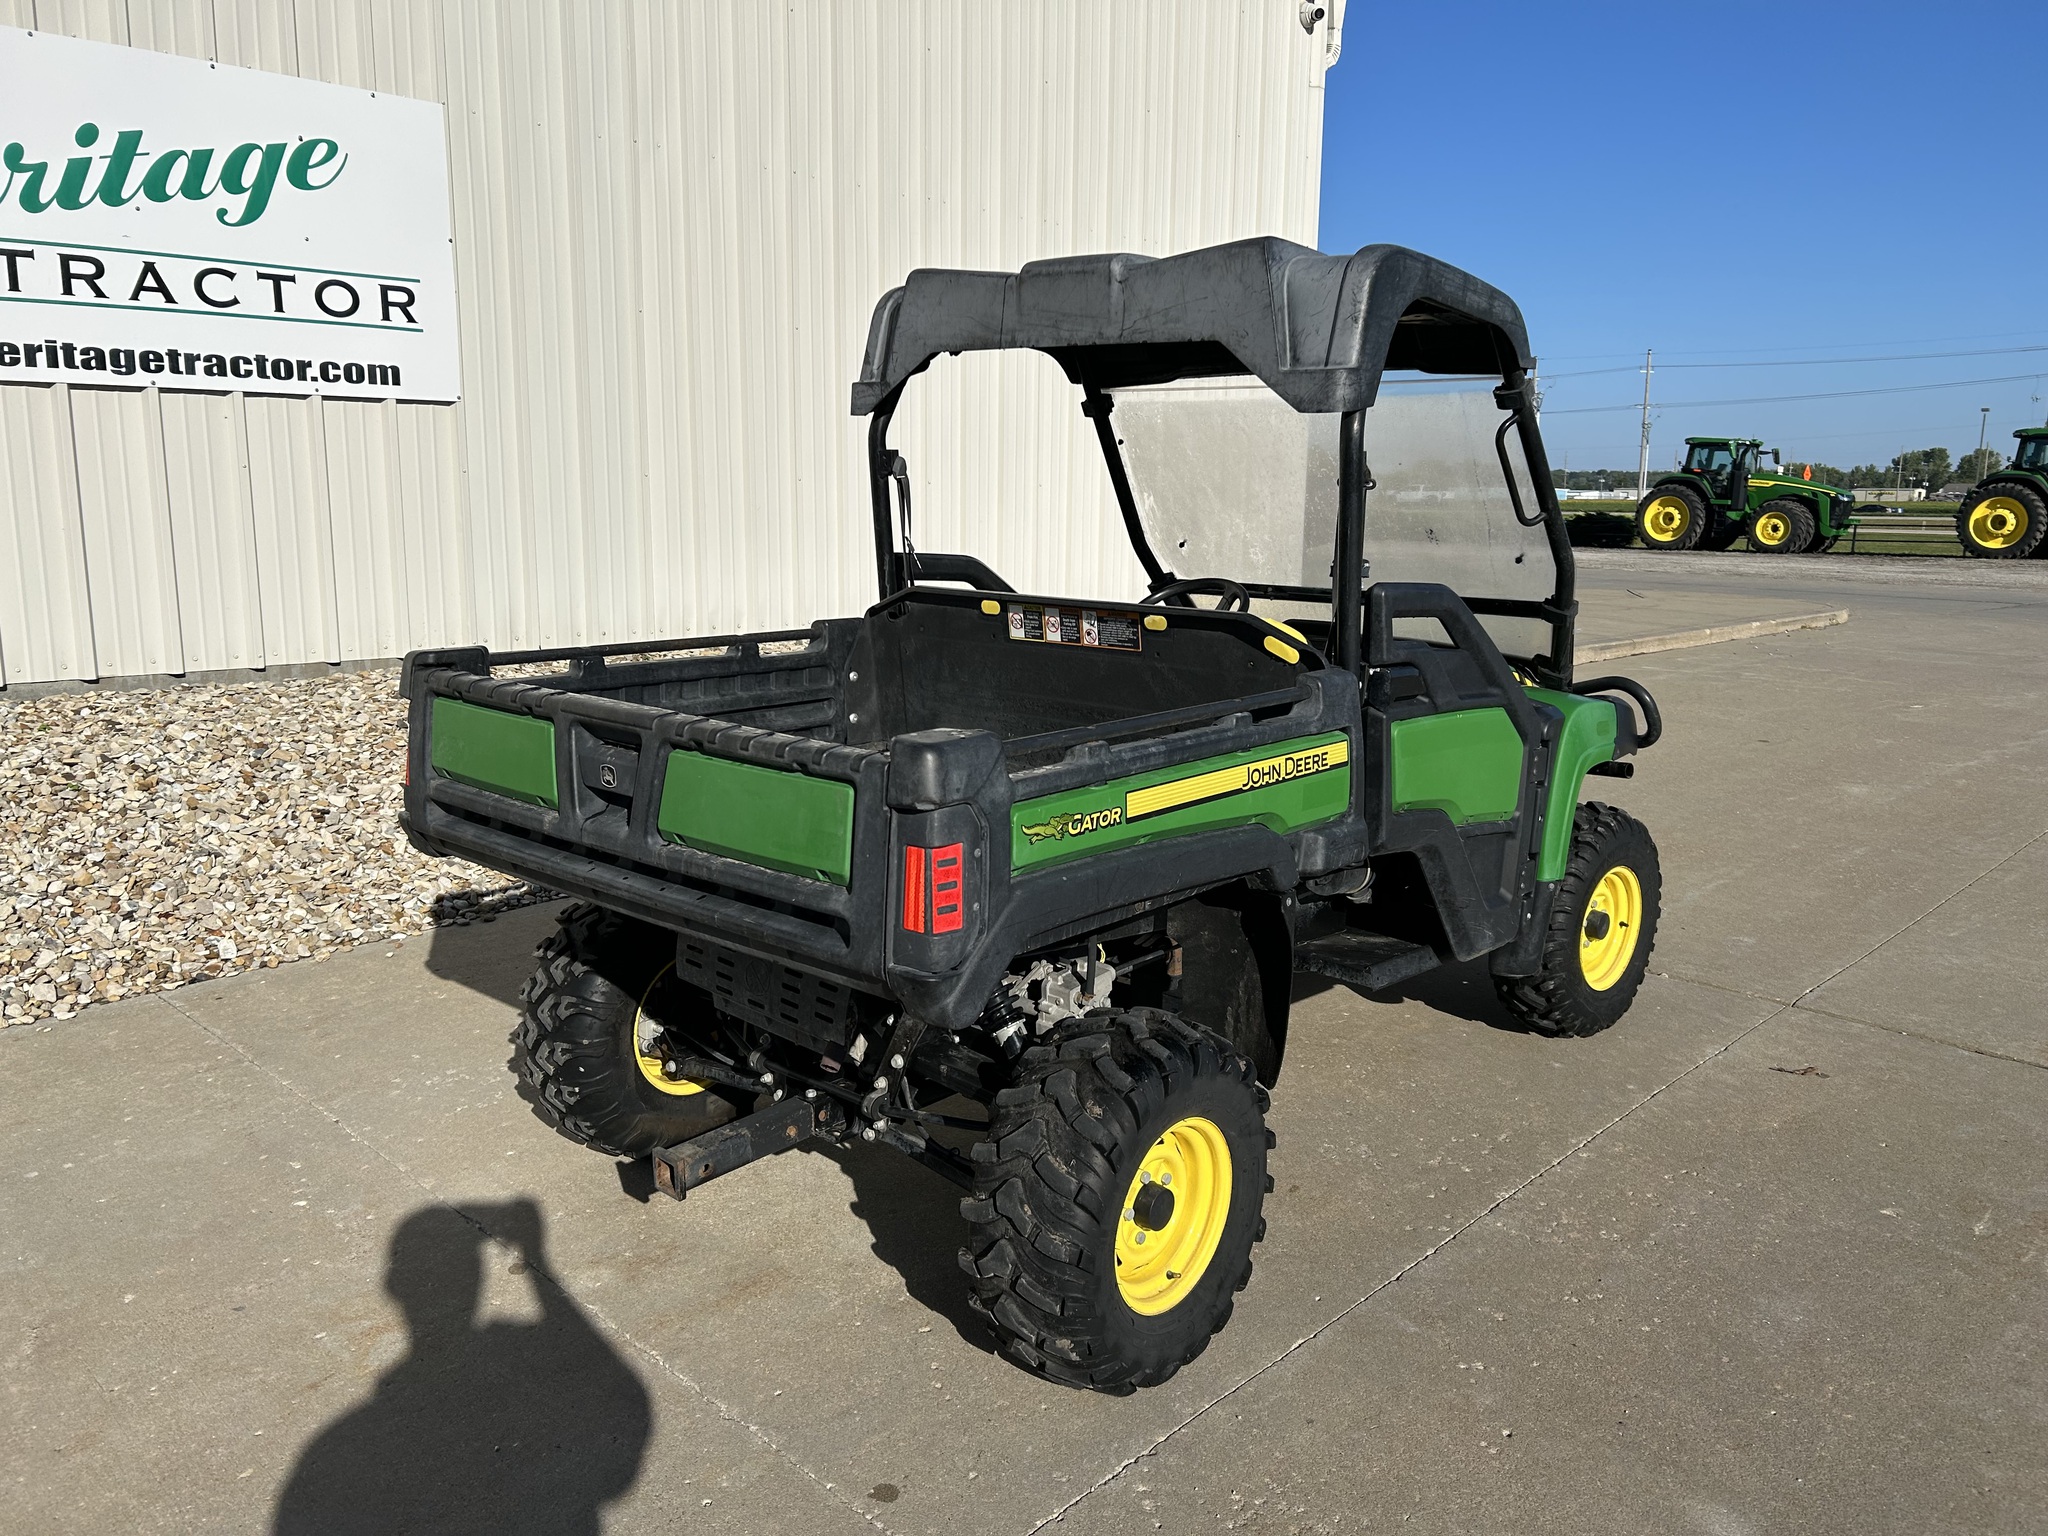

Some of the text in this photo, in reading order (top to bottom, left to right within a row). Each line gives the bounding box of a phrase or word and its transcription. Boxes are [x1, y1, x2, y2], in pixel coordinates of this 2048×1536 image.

[0, 249, 418, 324] TRACTOR
[0, 339, 401, 386] eritagetractor.com
[1242, 751, 1329, 788] JOHN DEERE
[1068, 807, 1122, 836] GATOR
